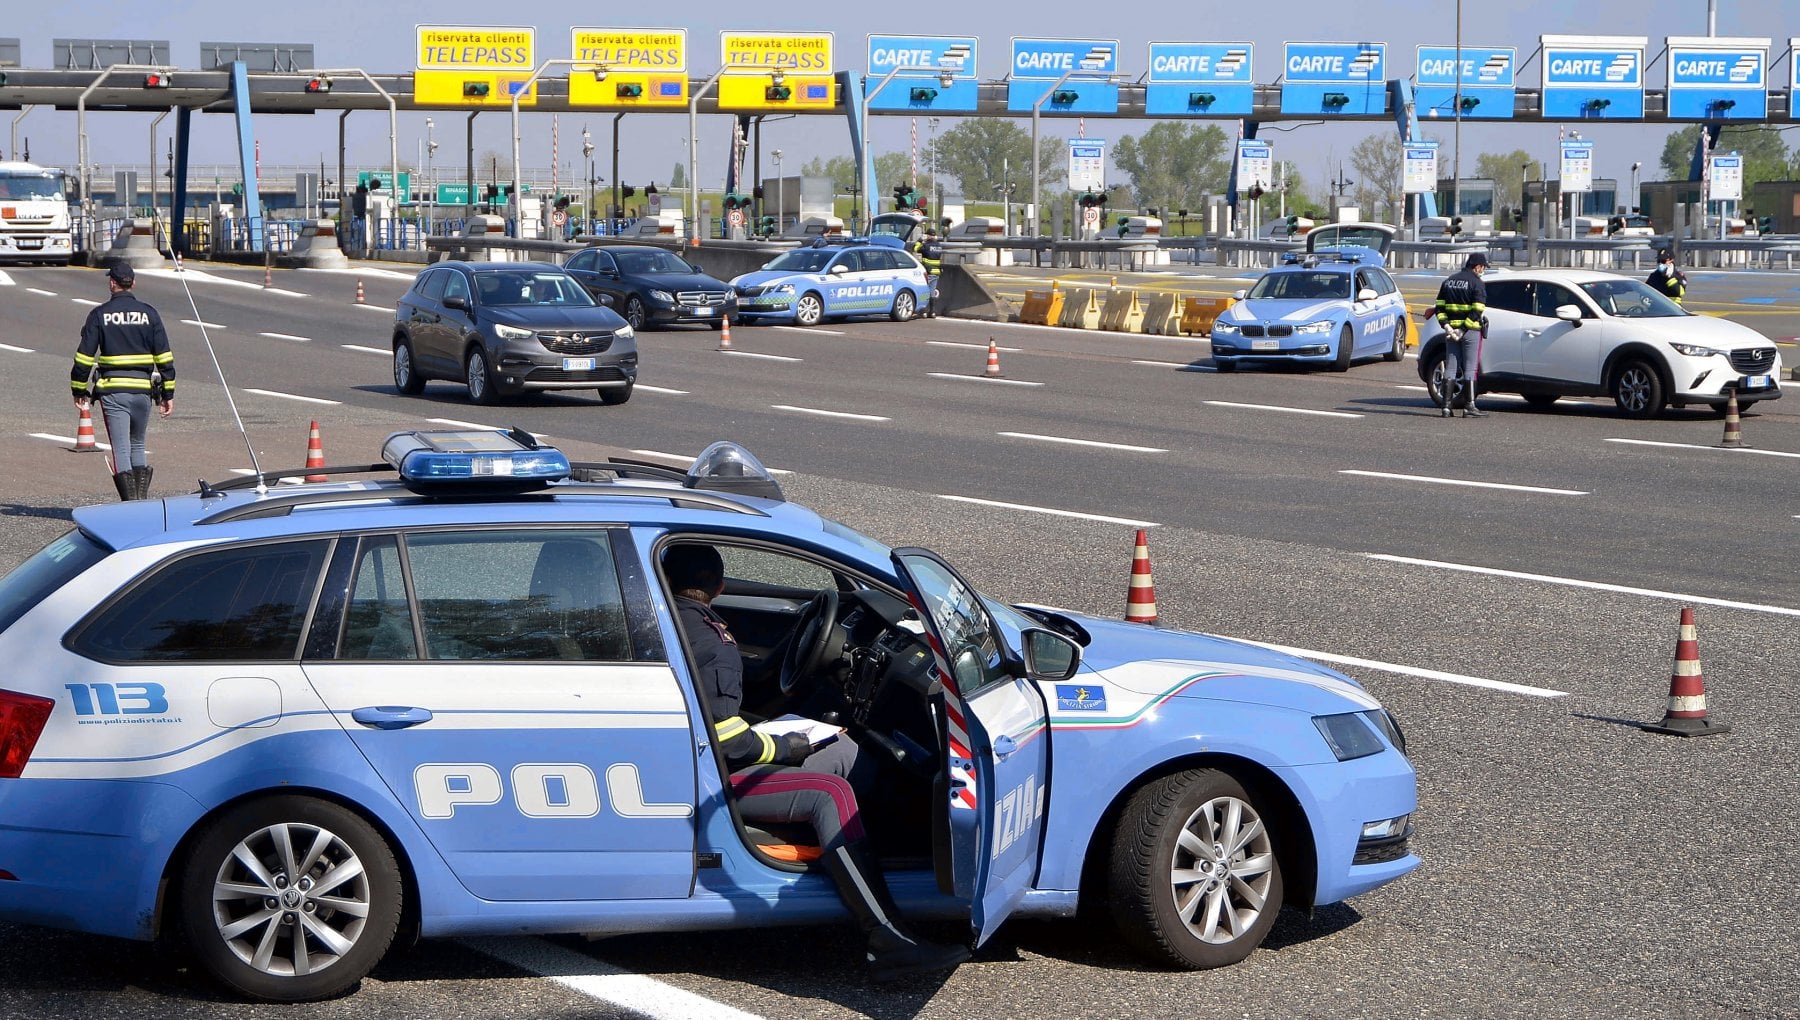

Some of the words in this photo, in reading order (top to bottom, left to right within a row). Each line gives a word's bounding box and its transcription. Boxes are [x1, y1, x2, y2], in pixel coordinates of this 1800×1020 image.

[427, 33, 481, 43] riservata
[486, 33, 525, 43] clienti
[581, 34, 633, 44] riservata
[639, 35, 677, 45] clienti
[730, 38, 782, 48] riservata
[786, 38, 823, 48] clienti
[425, 46, 527, 63] TELEPASS
[580, 48, 678, 65] TELEPASS
[729, 51, 826, 68] TELEPASS
[872, 48, 932, 66] CARTE
[1016, 51, 1074, 69] CARTE
[1153, 55, 1210, 72] CARTE
[1288, 55, 1343, 72] CARTE
[1420, 58, 1474, 75] CARTE
[1550, 59, 1601, 75] CARTE
[1676, 60, 1727, 76] CARTE
[837, 284, 893, 298] POLIZIA
[1445, 279, 1468, 290] POLIZIA
[103, 311, 150, 326] POLIZIA
[1363, 313, 1396, 337] POLIZIA
[64, 682, 169, 716] 113
[413, 762, 695, 819] POL
